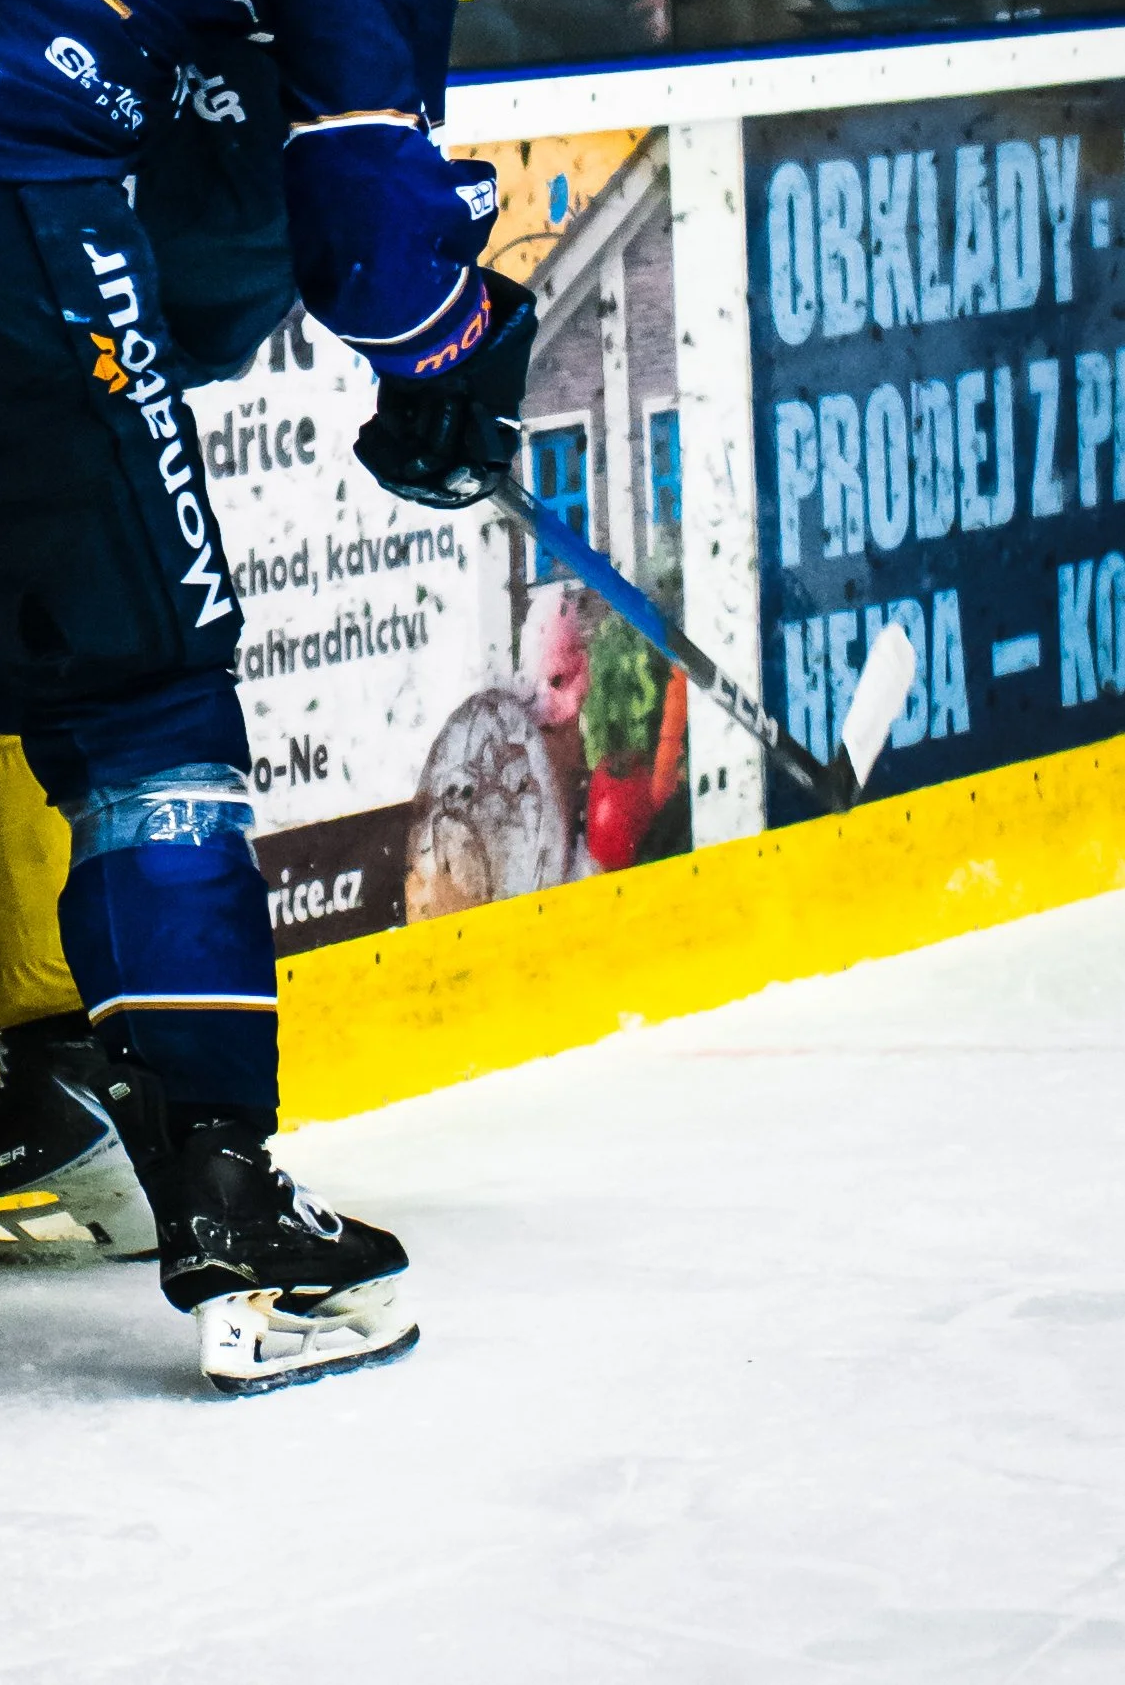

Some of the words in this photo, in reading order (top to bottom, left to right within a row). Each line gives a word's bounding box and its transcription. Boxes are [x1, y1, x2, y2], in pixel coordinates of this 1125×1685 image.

[767, 135, 1080, 346] OBKLADY
[82, 243, 233, 628] Monatour
[776, 366, 1015, 568] PRODEJ
[1028, 358, 1063, 518] Z
